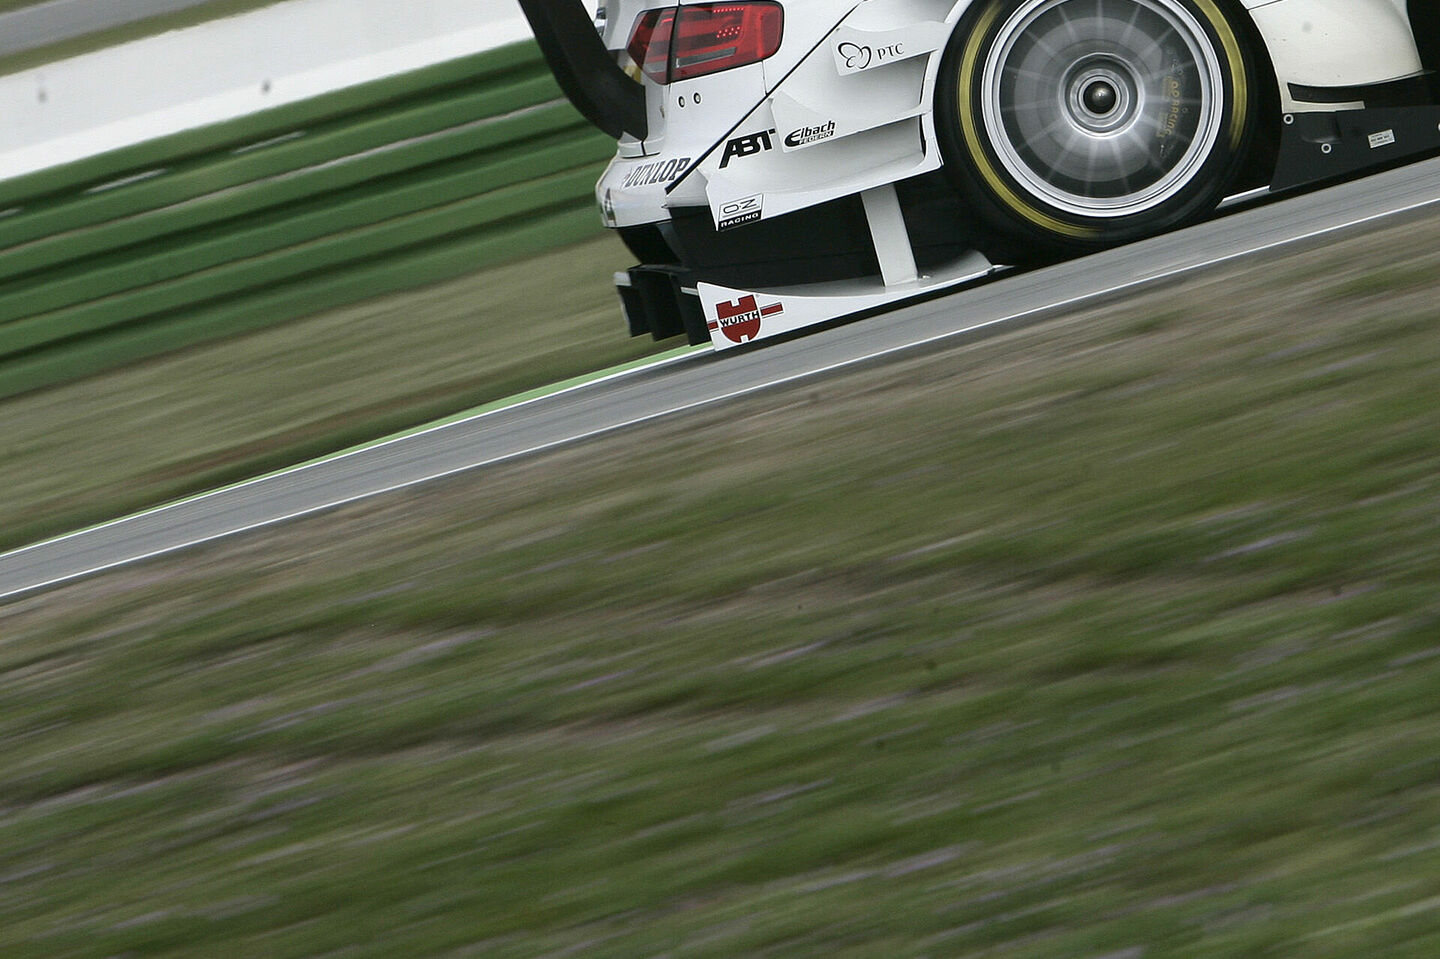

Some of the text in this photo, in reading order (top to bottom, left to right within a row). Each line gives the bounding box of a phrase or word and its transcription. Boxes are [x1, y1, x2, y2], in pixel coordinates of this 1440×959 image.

[877, 43, 905, 60] PTC
[719, 128, 776, 169] ABT
[624, 157, 691, 188] DUNLOP
[720, 212, 759, 228] RACING
